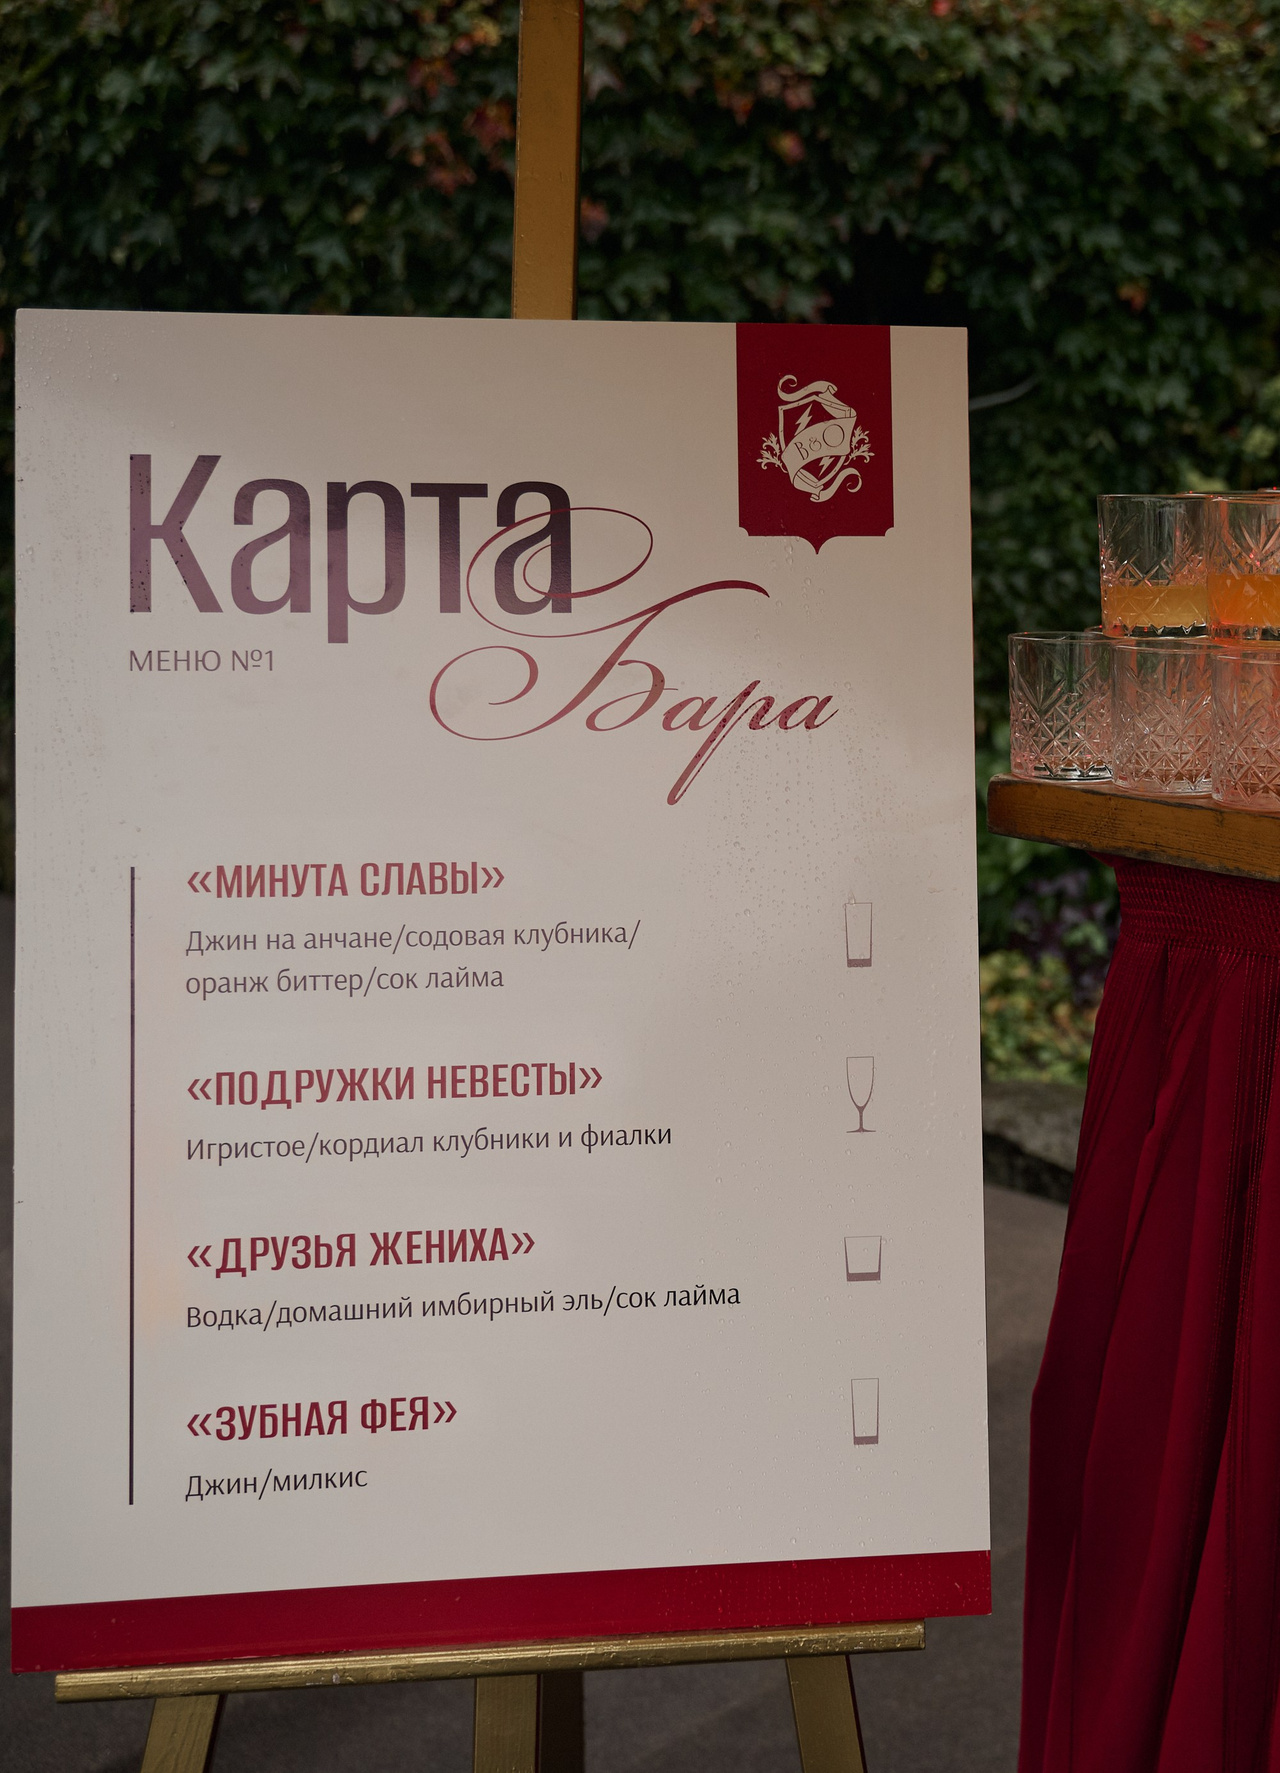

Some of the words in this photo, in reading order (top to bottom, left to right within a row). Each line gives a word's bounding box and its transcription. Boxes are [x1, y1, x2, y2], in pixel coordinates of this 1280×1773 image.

[129, 454, 573, 643] Карта
[129, 649, 222, 672] МЕНЮ
[231, 649, 273, 672] №1
[430, 507, 838, 805] Бара
[186, 863, 349, 899] «МИНУТА
[360, 861, 505, 897] СЛАВЫ»
[185, 930, 257, 957] Джин
[265, 932, 296, 950] на
[303, 923, 505, 955] анчане/содовая
[514, 919, 642, 952] клубника/
[185, 975, 269, 1002] оранж
[276, 966, 419, 998] биттер/сок
[425, 966, 505, 989] лайма
[187, 1066, 415, 1111] «ПОДРУЖКИ
[427, 1061, 603, 1100] НЕВЕСТЫ»
[187, 1131, 424, 1167] Игристое/кордиал
[432, 1127, 550, 1156] клубники
[558, 1130, 573, 1148] и
[580, 1123, 672, 1155] фиалки
[186, 1232, 356, 1279] «ДРУЗЬЯ
[369, 1227, 536, 1267] ЖЕНИХА»
[187, 1296, 413, 1332] Водка/домашний
[422, 1290, 554, 1322] имбирный
[562, 1285, 657, 1317] эль/сок
[663, 1283, 742, 1308] лайма
[186, 1399, 348, 1442] «ЗУБНАЯ
[360, 1395, 458, 1434] ФЕЯ»
[184, 1467, 368, 1503] Джин/милкис
